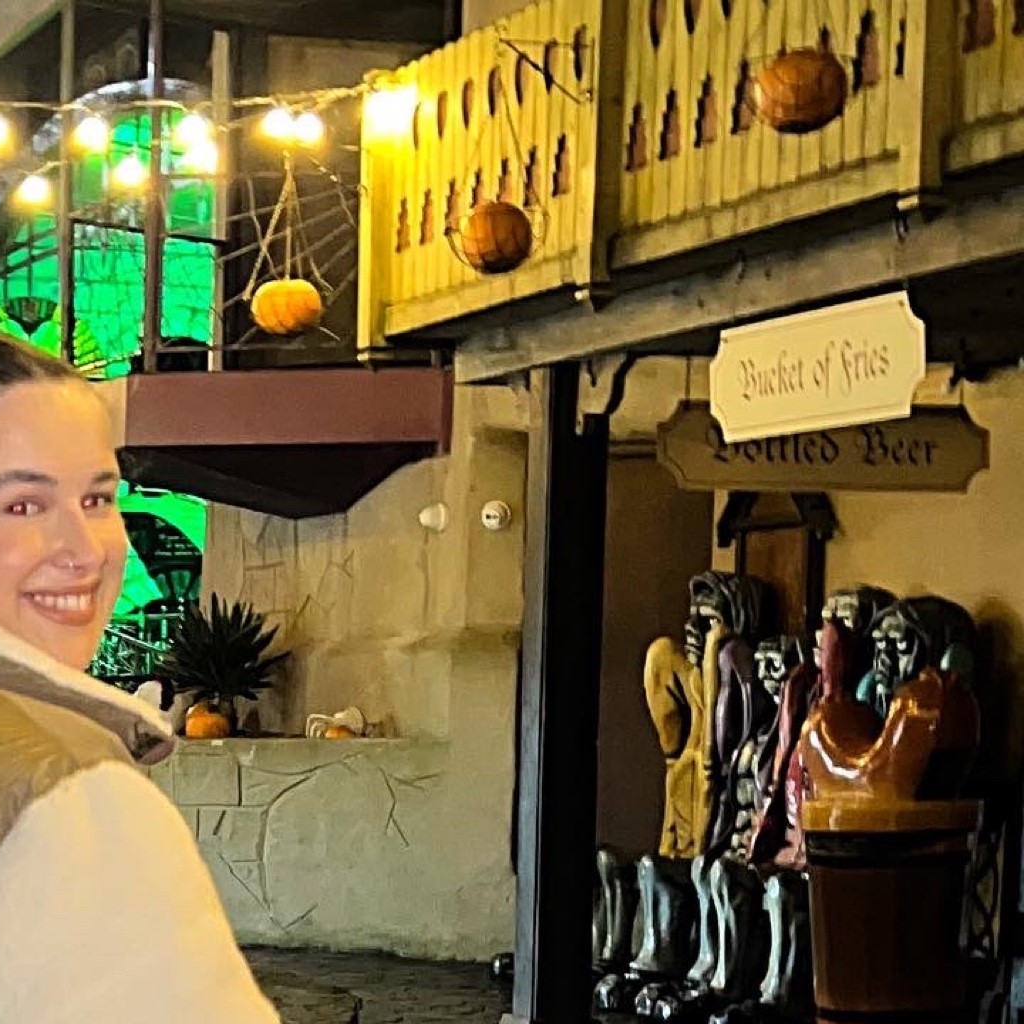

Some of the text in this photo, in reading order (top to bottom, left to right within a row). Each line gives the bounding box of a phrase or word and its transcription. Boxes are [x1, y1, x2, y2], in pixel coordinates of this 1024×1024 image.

[739, 350, 804, 402] Bucket
[813, 340, 836, 399] of
[857, 426, 939, 466] Beer
